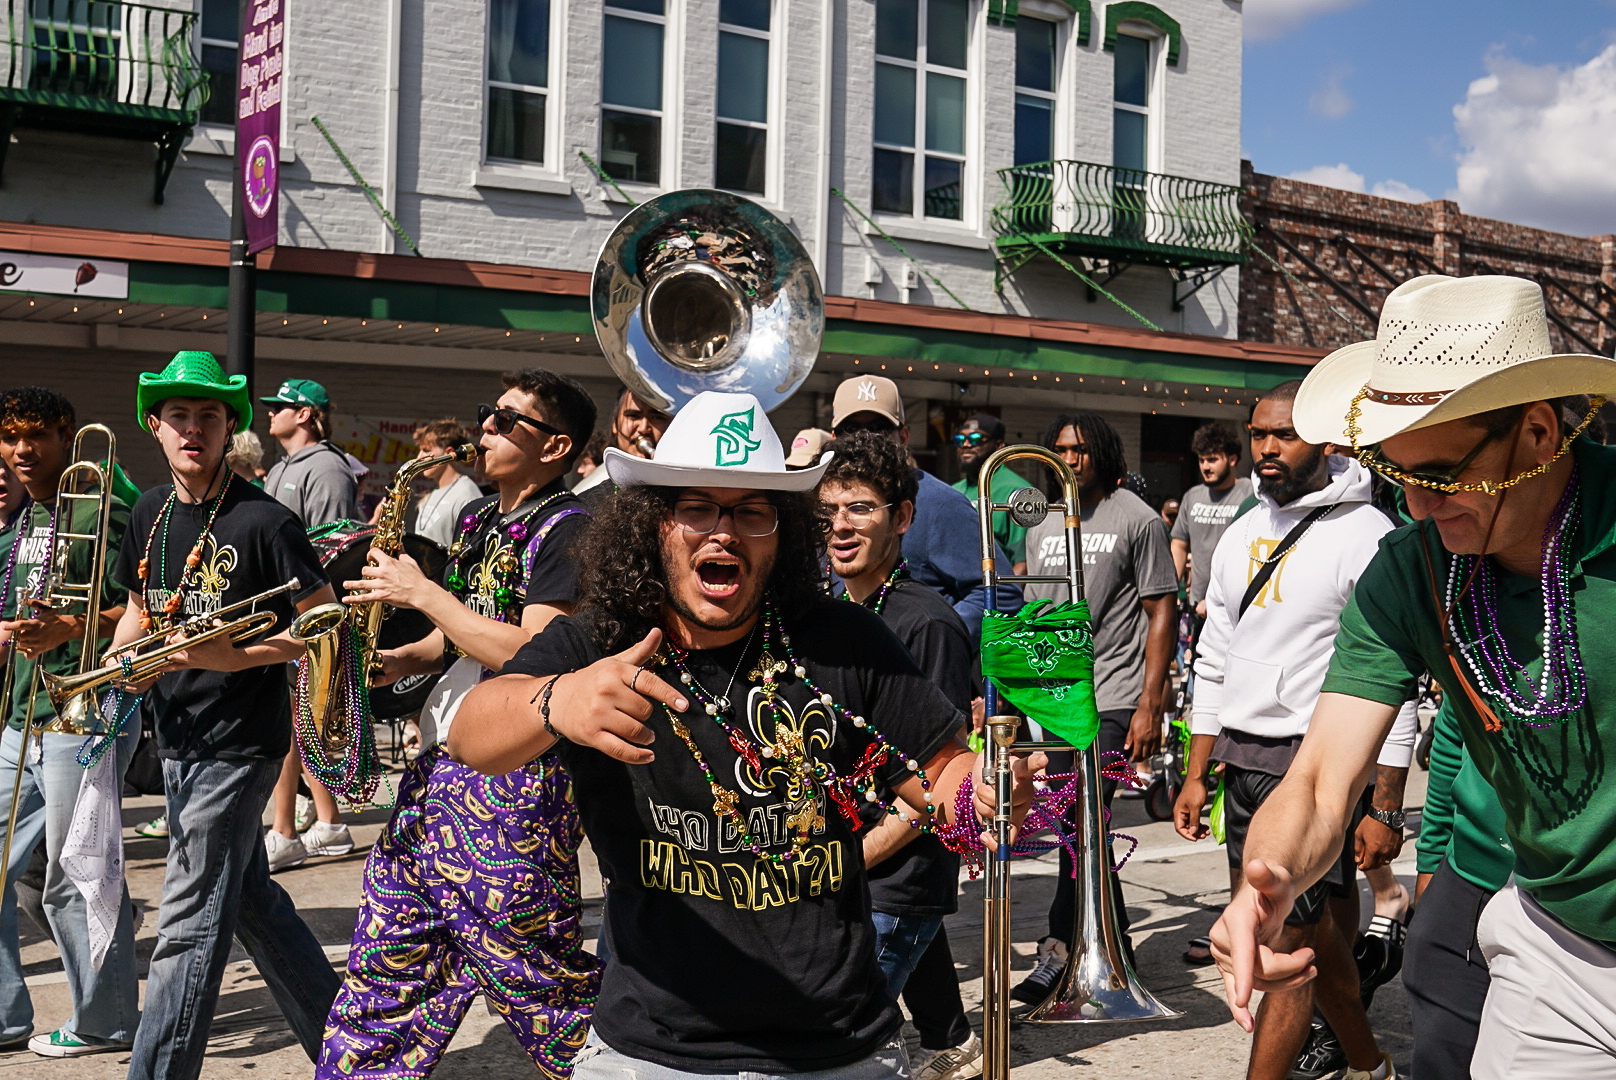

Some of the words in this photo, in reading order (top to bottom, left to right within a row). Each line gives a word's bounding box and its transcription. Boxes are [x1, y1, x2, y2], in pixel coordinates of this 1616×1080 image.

[241, 62, 260, 90] Dog
[1015, 501, 1048, 514] CONN
[1190, 503, 1240, 518] STETSON
[1193, 516, 1226, 525] FOOTBALL
[32, 526, 54, 538] STETS
[18, 537, 56, 565] MUS
[1039, 533, 1118, 560] STESON
[1044, 554, 1097, 567] FOOLL
[178, 588, 222, 615] AT?!
[397, 674, 425, 691] EVAN
[648, 797, 709, 851] WHO
[640, 839, 724, 901] WHO
[722, 840, 842, 911] DAT?!
